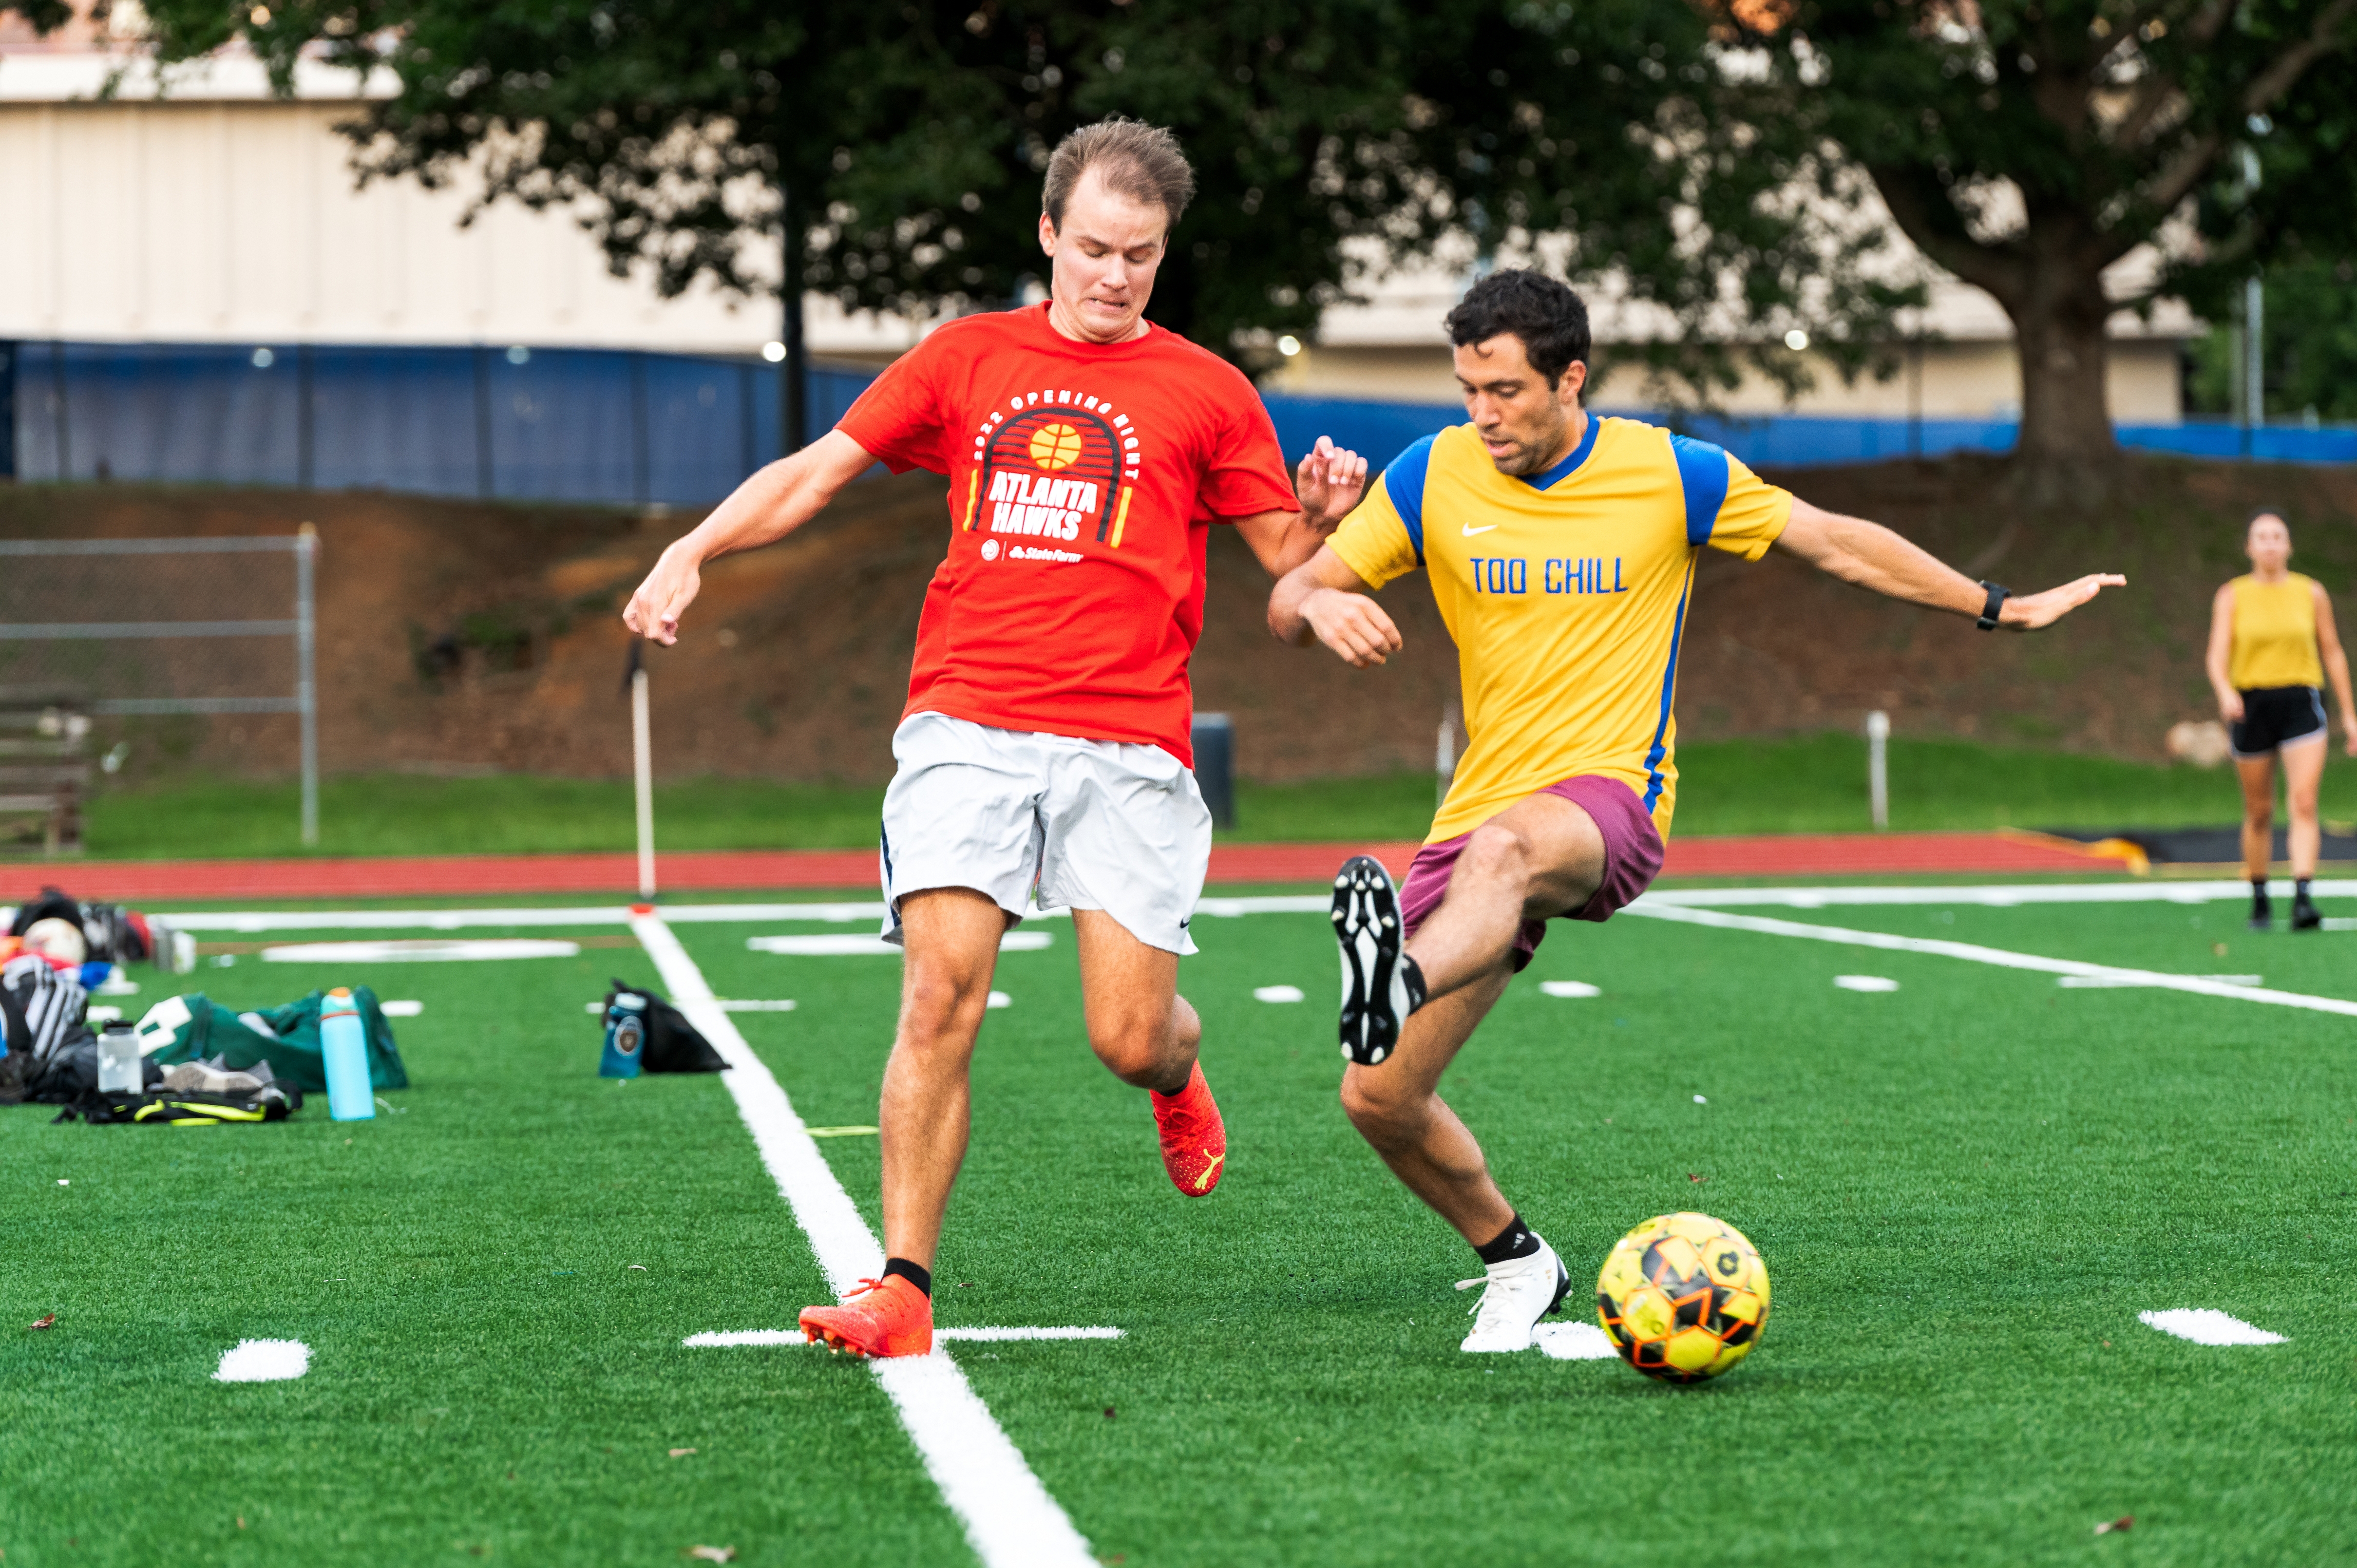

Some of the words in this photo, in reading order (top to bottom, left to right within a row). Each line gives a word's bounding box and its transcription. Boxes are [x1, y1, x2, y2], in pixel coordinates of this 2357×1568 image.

[973, 411, 1004, 461] 2022
[1010, 389, 1112, 415] OPENING
[1113, 413, 1141, 480] NIGHT
[988, 471, 1098, 513] ATLANTA
[990, 502, 1082, 541] HAWKS
[1469, 557, 1527, 594] TOO
[1544, 556, 1629, 594] CHILL
